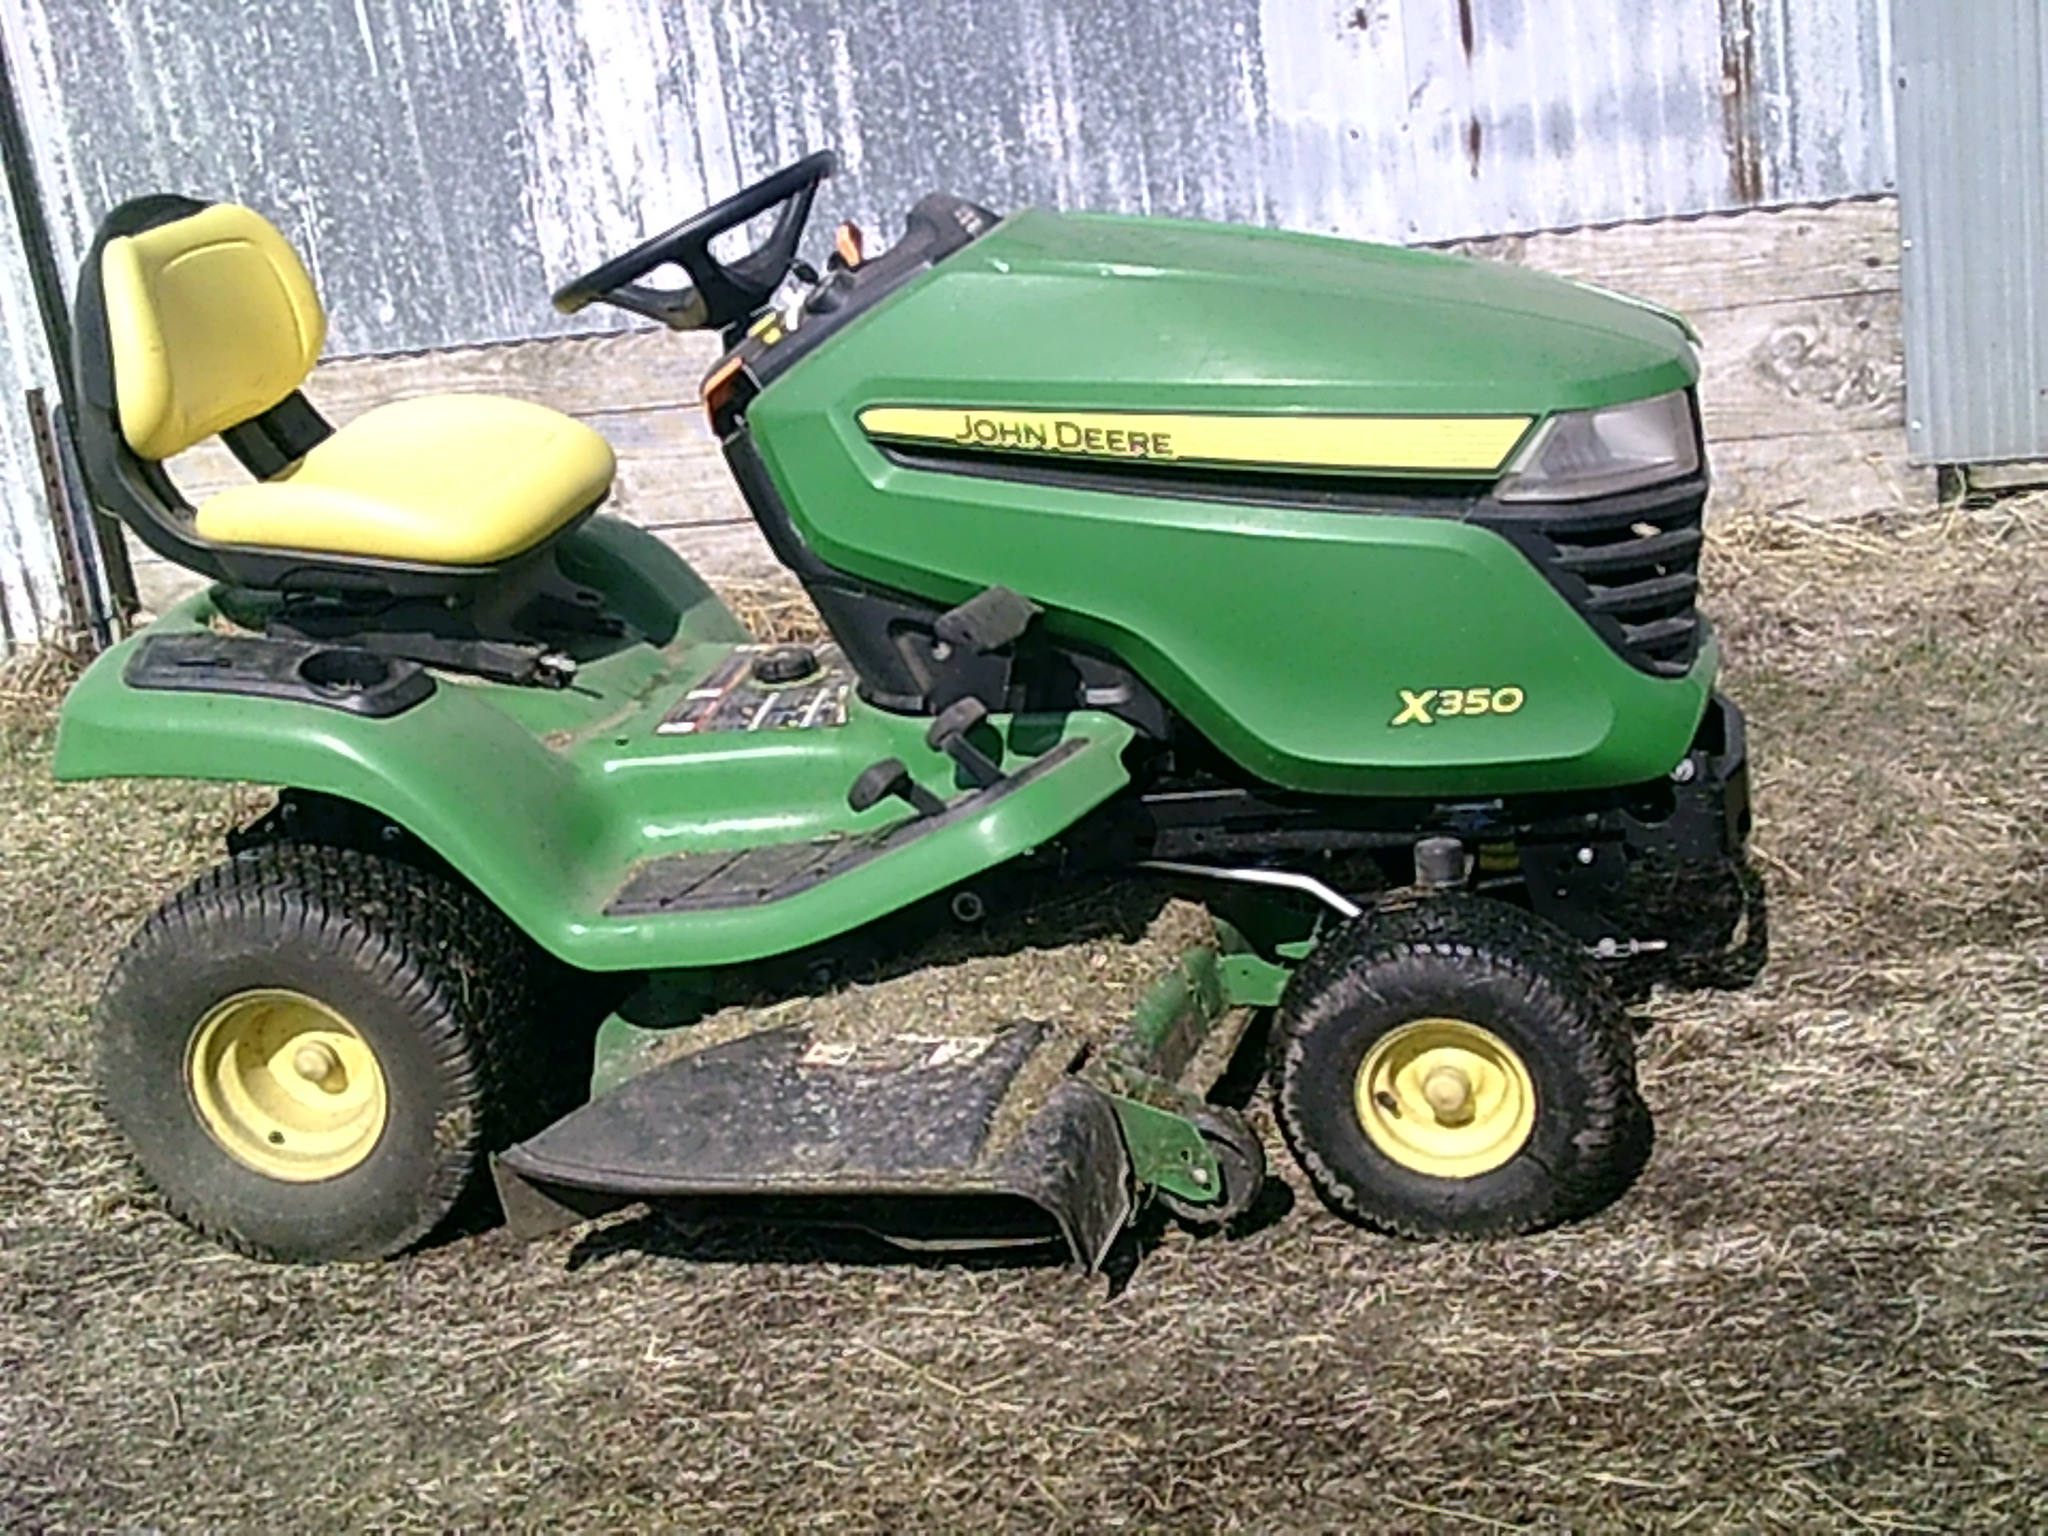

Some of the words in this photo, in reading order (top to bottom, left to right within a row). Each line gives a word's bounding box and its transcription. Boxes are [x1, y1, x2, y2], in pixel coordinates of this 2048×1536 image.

[955, 414, 1048, 446] JOHN
[1054, 421, 1174, 455] DEERE
[1389, 685, 1526, 727] X350
